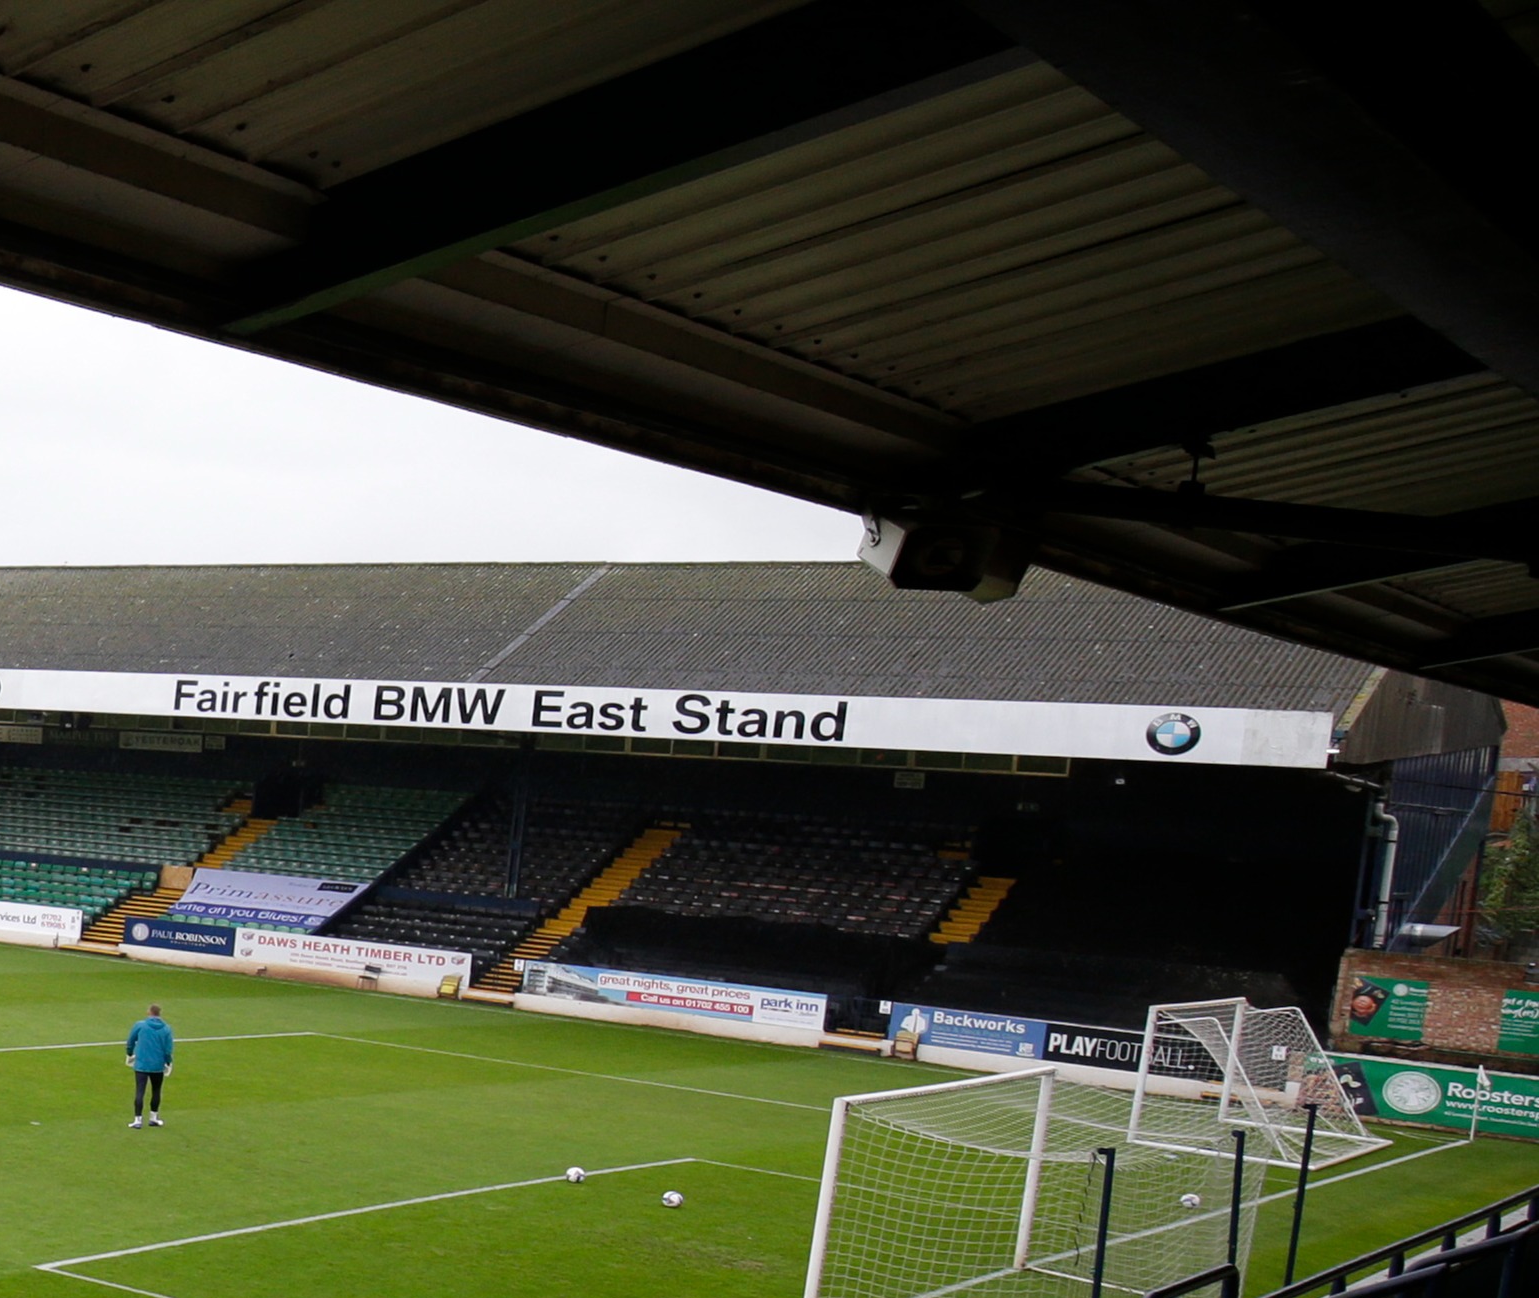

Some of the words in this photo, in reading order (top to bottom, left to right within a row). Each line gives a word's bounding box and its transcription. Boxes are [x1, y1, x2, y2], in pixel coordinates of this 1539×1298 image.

[174, 680, 352, 720] Fairfield
[373, 685, 506, 725] BMW
[531, 690, 649, 733] East
[672, 693, 848, 742] Stand
[23, 914, 37, 924] Ltd
[227, 908, 255, 918] you
[151, 929, 173, 940] PAUL
[173, 931, 227, 946] ROBINSON
[257, 935, 297, 948] DAWS
[302, 940, 351, 956] HEATH
[357, 946, 413, 963] TIMBER
[417, 953, 447, 966] LTD
[599, 976, 631, 988] great
[633, 978, 673, 992] nights,
[676, 983, 709, 996] great
[711, 987, 751, 1000] prices
[640, 993, 659, 1002] Call
[660, 996, 671, 1004] us
[673, 998, 685, 1006] on
[685, 998, 713, 1010] 01702
[733, 1003, 749, 1014] 100
[760, 997, 793, 1011] park
[795, 1000, 819, 1012] inn
[933, 1010, 1026, 1034] Backworks
